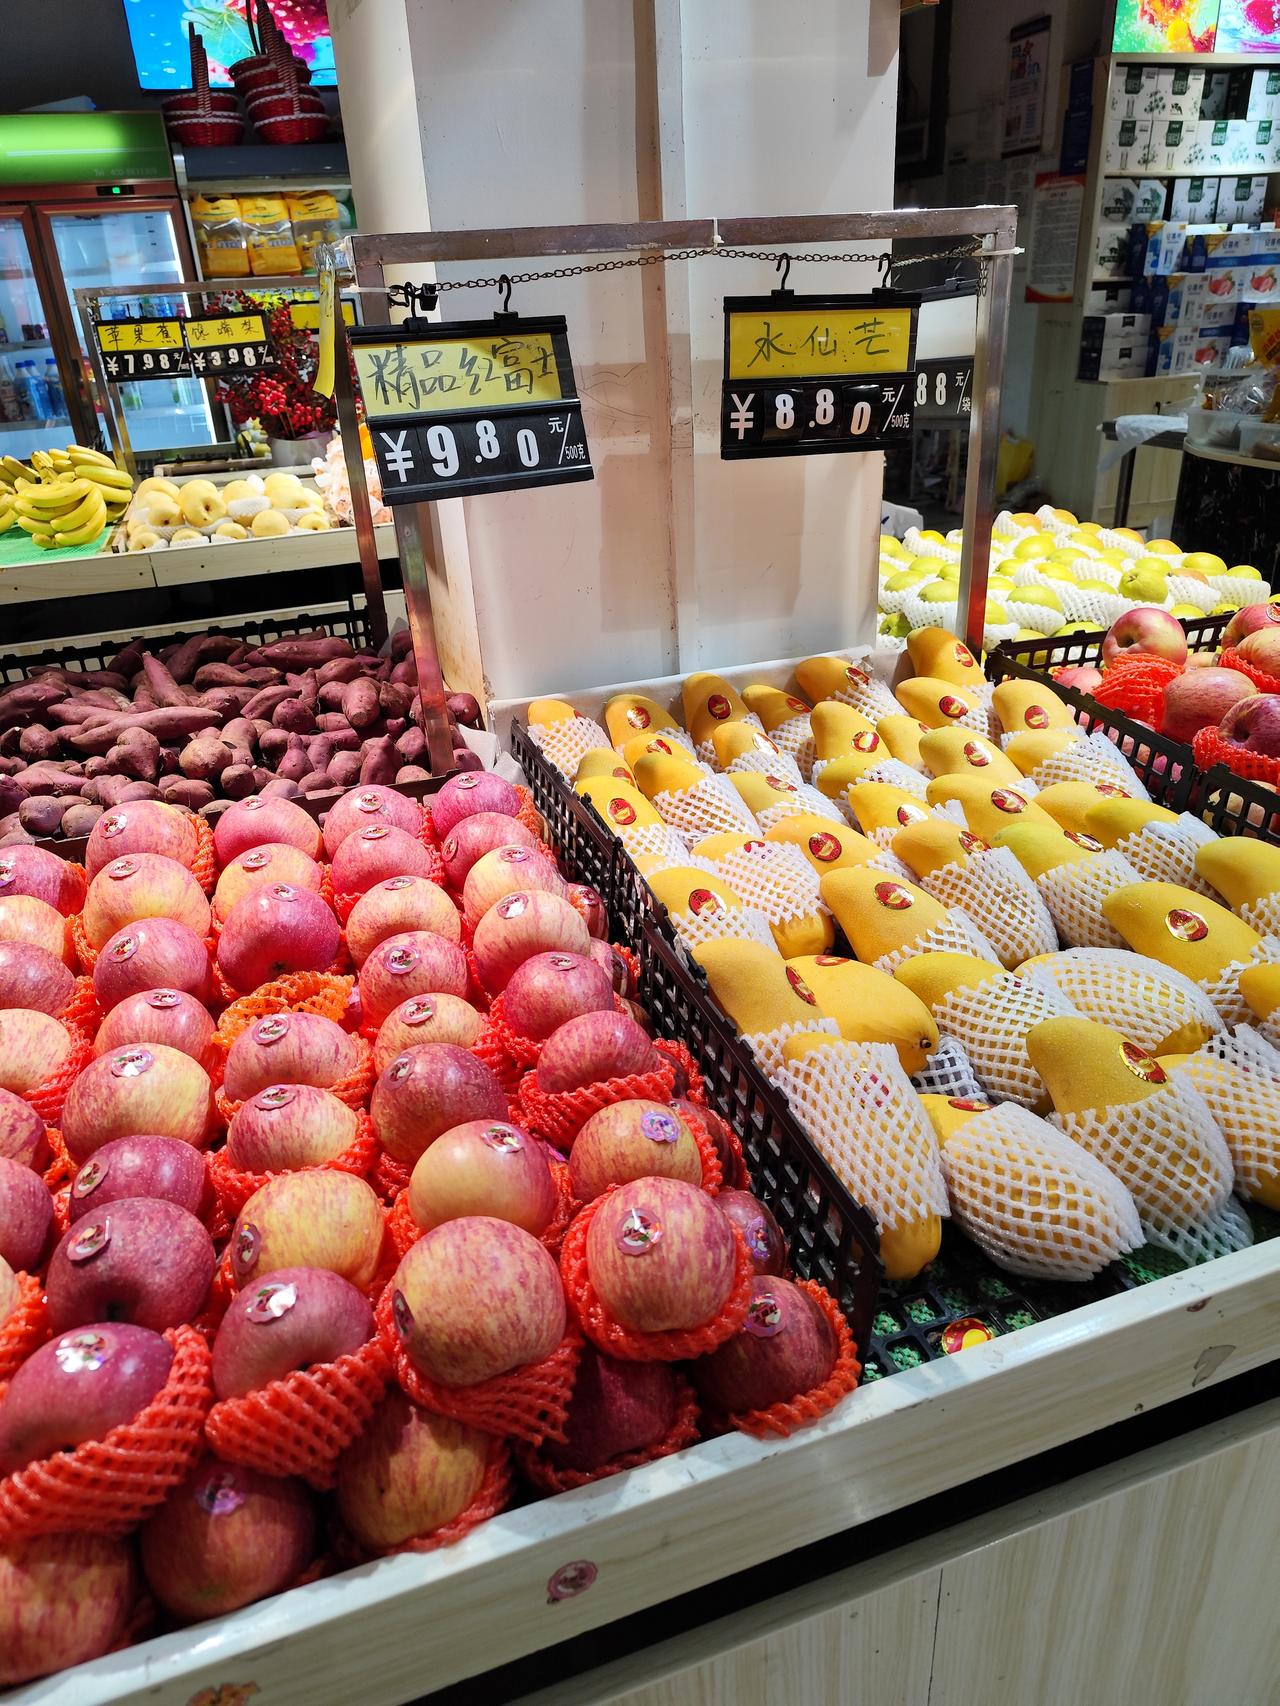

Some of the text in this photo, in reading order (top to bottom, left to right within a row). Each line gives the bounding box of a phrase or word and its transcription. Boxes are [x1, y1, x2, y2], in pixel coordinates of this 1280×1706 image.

[747, 317, 890, 368] 水仙芒
[366, 337, 555, 410] 精品红富士
[730, 388, 872, 440] ¥8.80
[380, 420, 541, 483] ¥9.80
